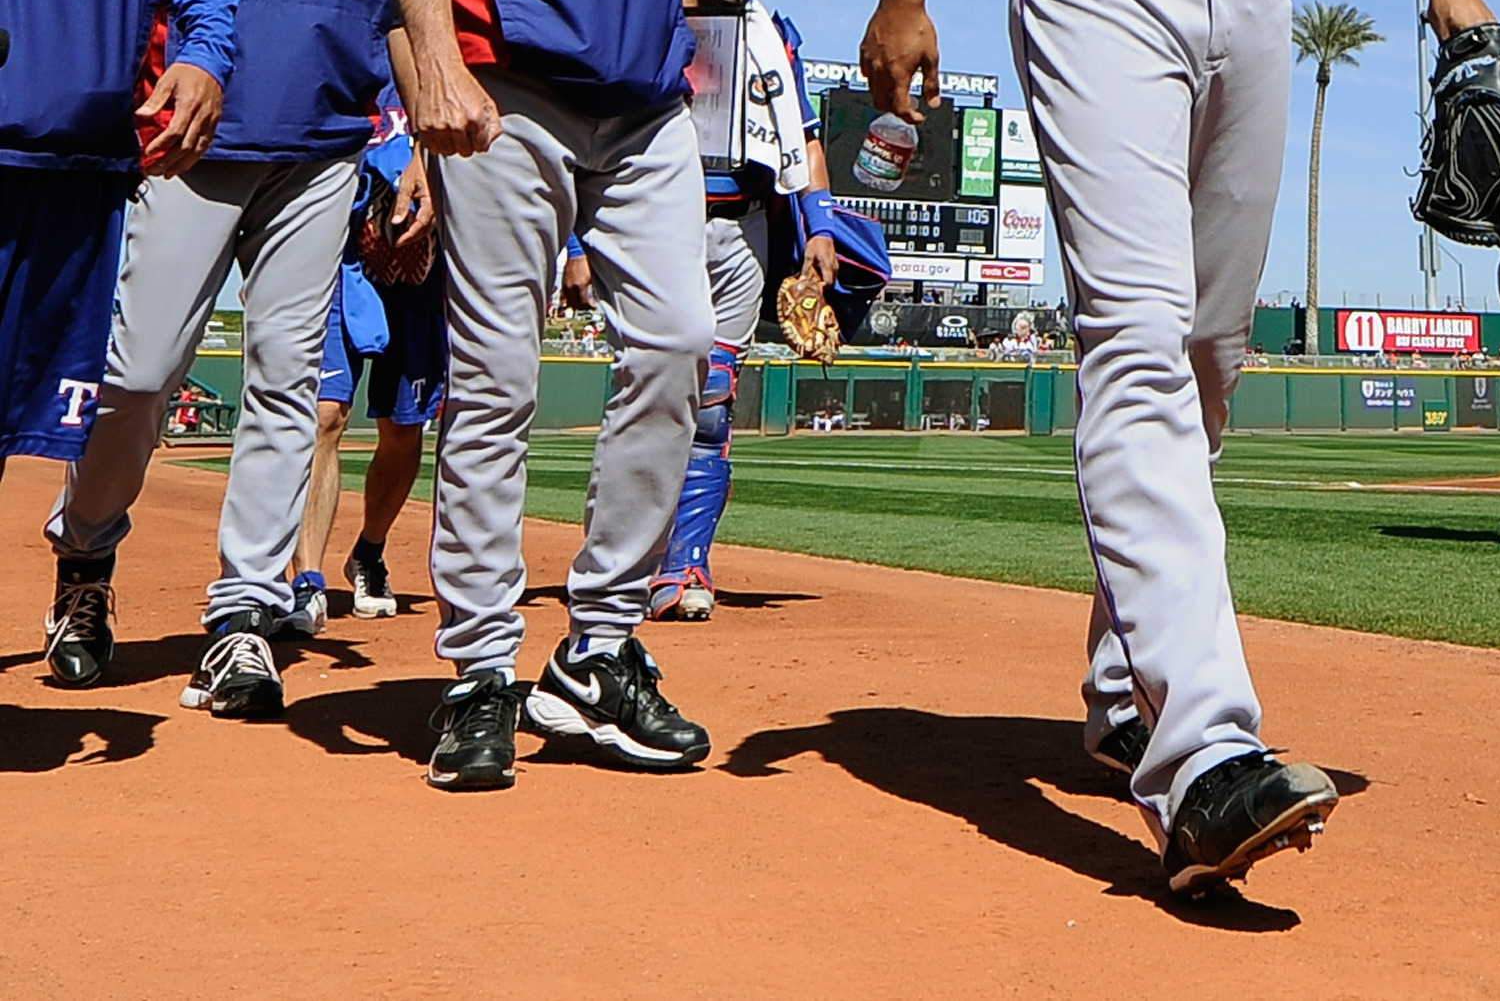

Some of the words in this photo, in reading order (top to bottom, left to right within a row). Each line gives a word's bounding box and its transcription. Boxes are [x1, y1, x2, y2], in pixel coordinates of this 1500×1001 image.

[1002, 208, 1043, 229] Coors
[1355, 316, 1375, 347] 11
[1429, 318, 1473, 337] LARKIN
[57, 378, 102, 428] T
